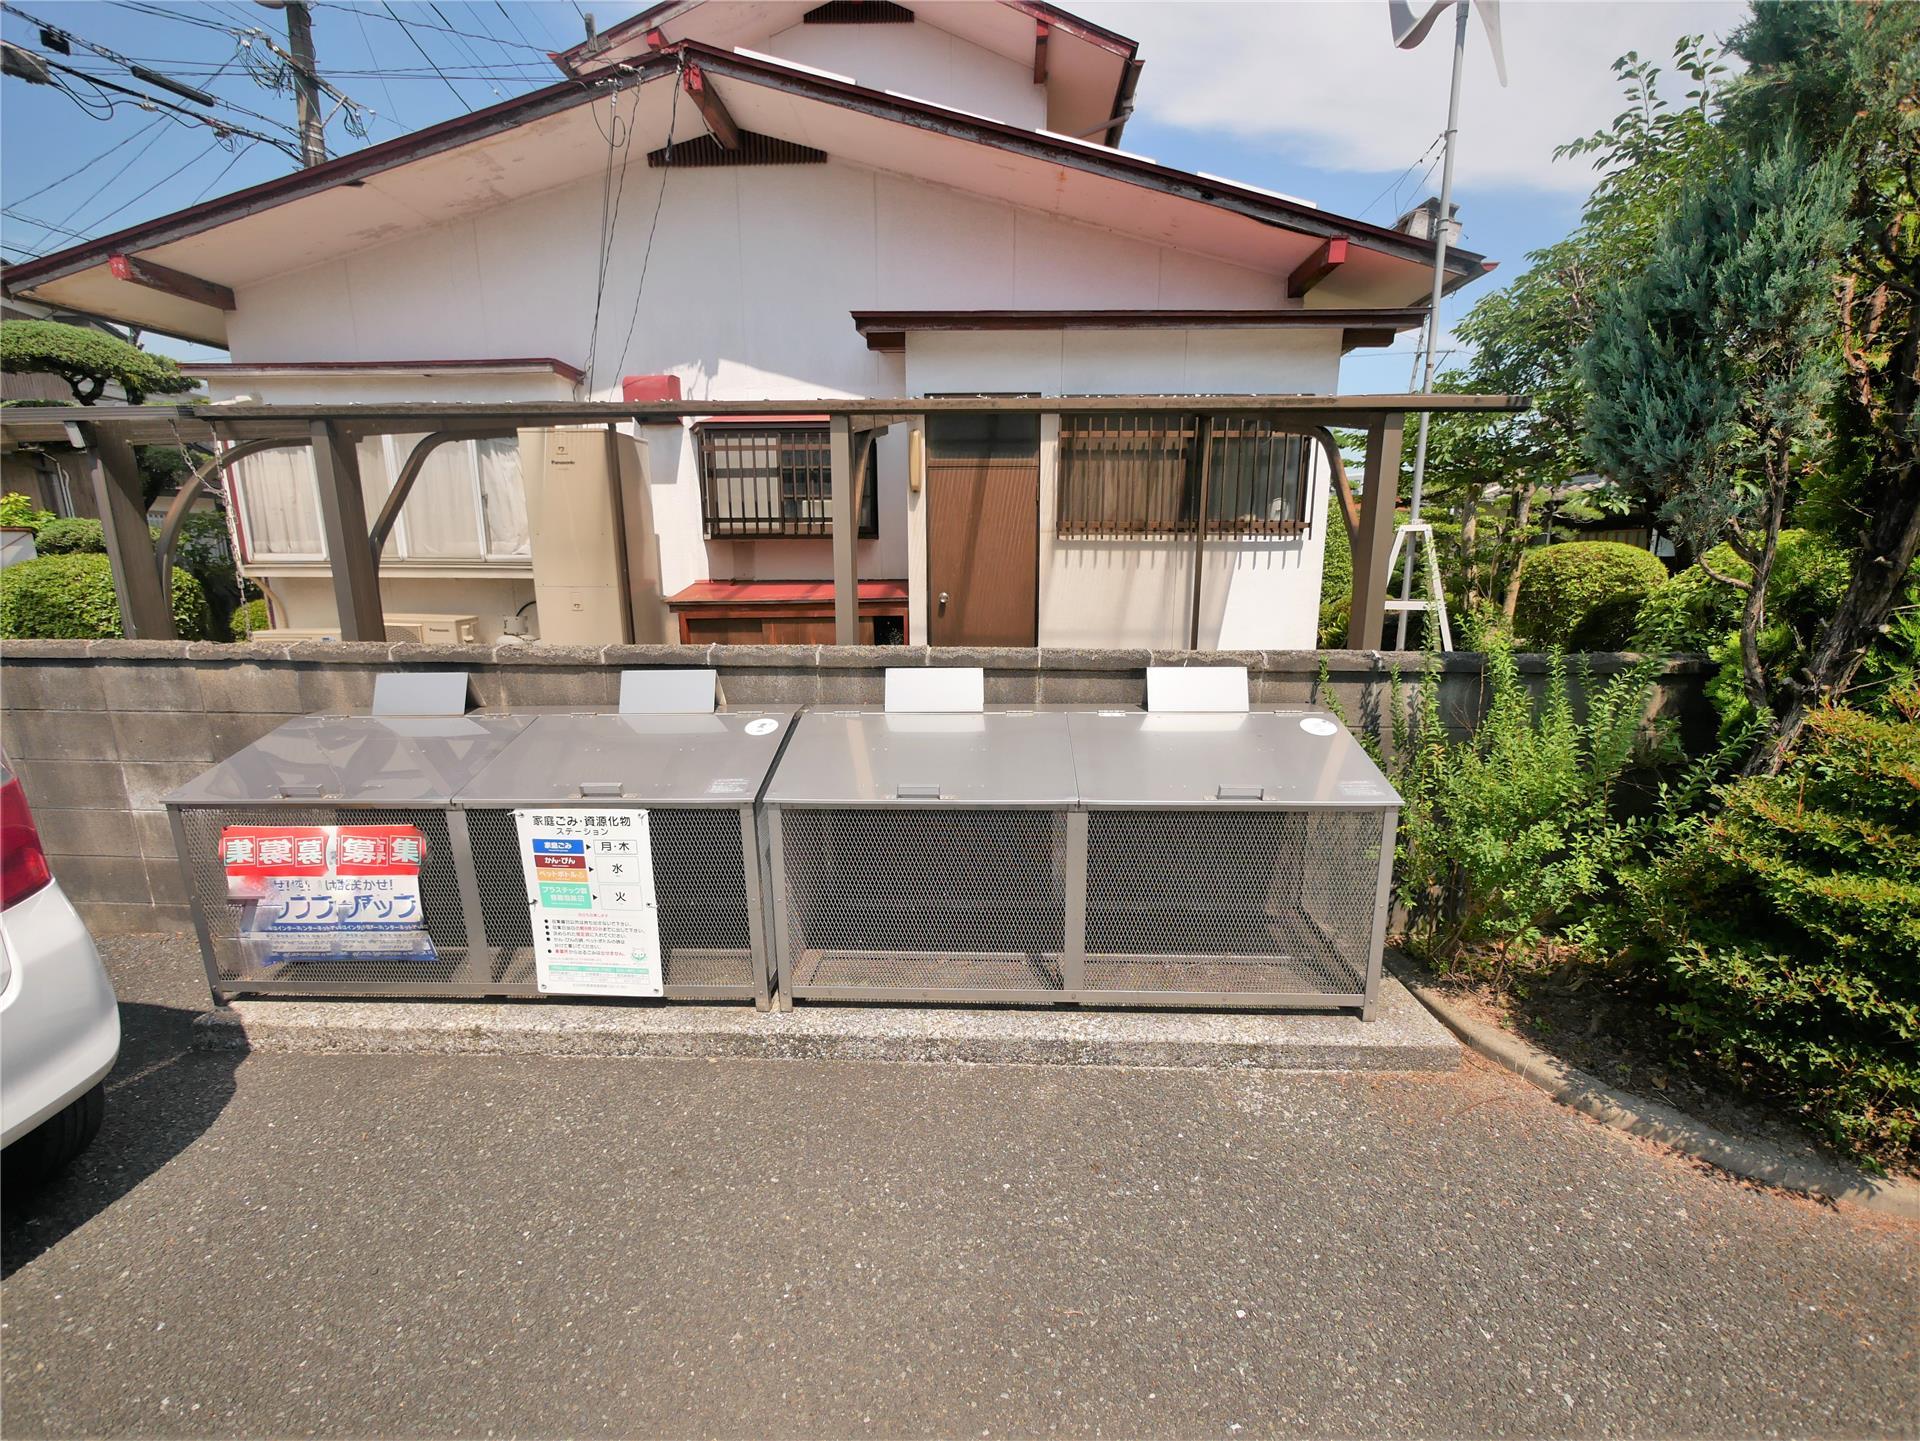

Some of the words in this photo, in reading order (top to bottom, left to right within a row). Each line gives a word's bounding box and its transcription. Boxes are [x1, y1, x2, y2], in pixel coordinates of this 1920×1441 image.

[532, 815, 631, 827] 家庭ごみ・資源化物
[556, 827, 609, 836] ステーション
[544, 841, 572, 849] 家庭ごみ
[601, 841, 630, 852] 月・木
[544, 857, 576, 865] かん・びん
[612, 863, 624, 874] 水
[615, 891, 626, 902] 火
